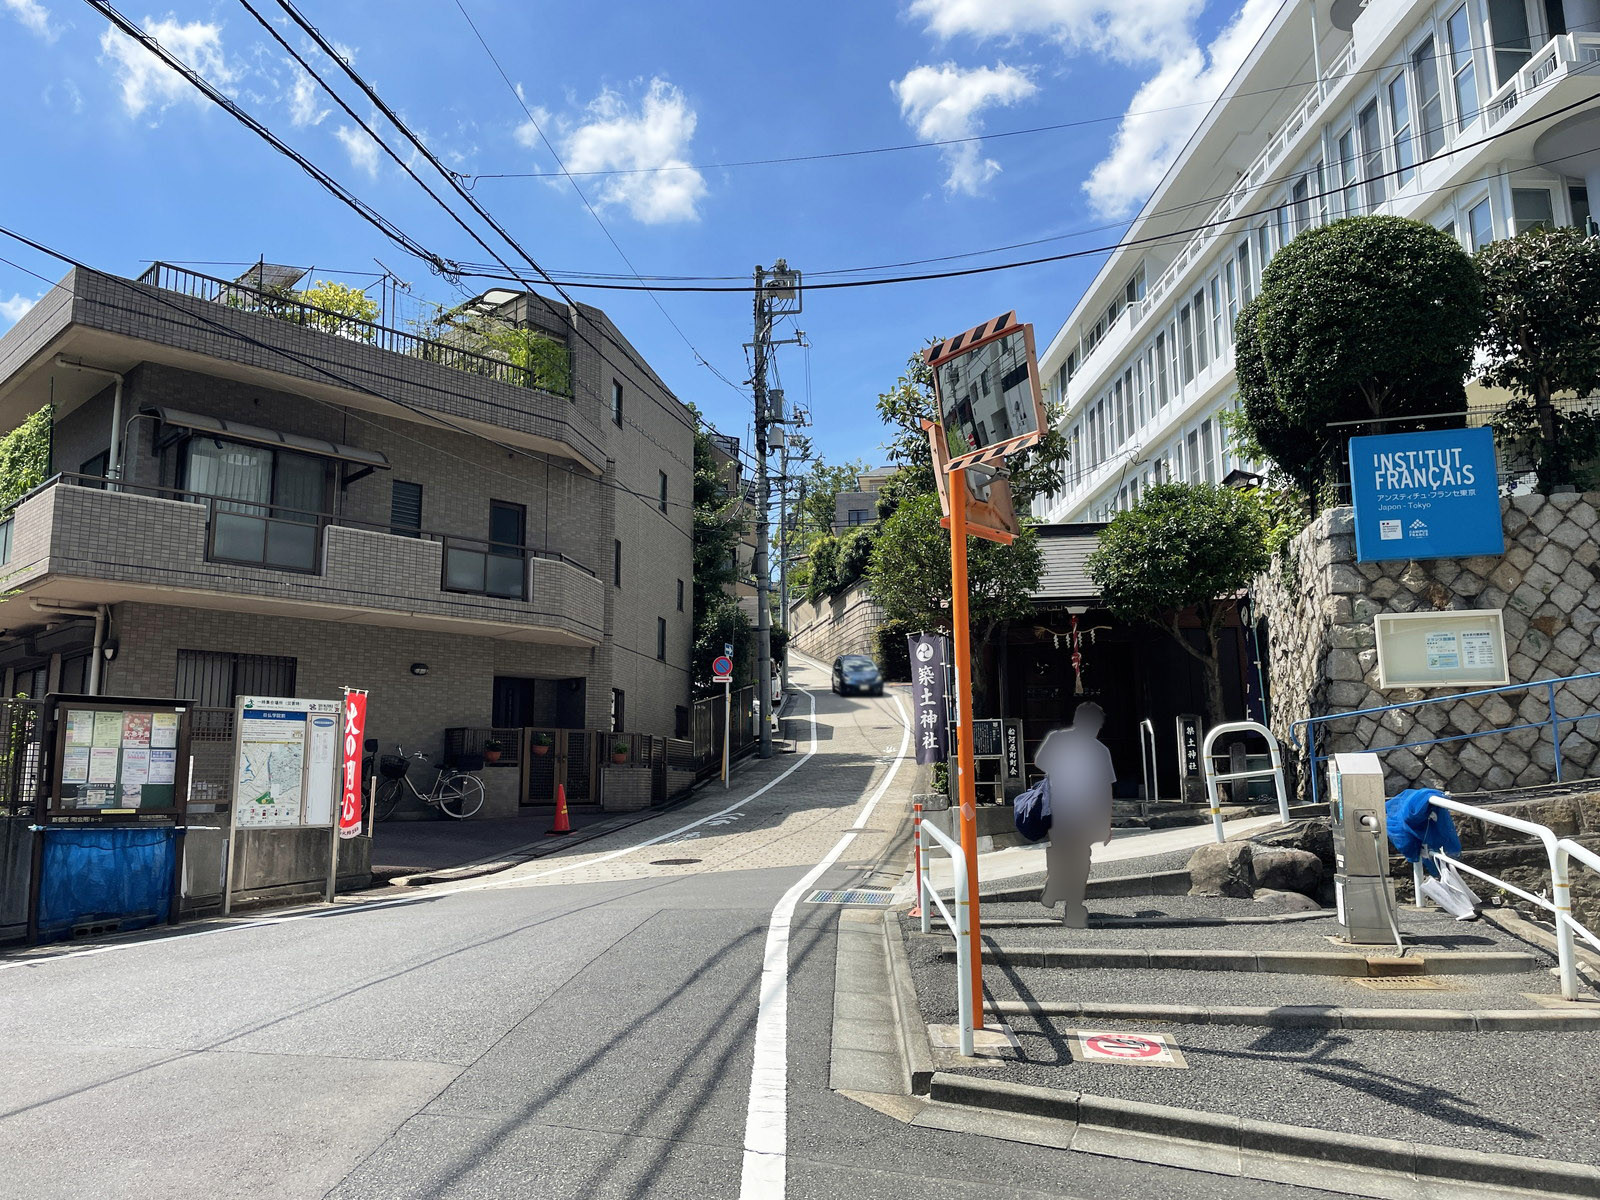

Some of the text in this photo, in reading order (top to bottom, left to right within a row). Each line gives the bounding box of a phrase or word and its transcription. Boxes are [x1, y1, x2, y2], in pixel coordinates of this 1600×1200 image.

[1373, 447, 1462, 474] INSTITUT
[1375, 464, 1475, 491] FRANÇAIS
[1378, 503, 1402, 512] Japon
[1407, 501, 1432, 510] Tokyo
[918, 666, 939, 750] 築土神社
[344, 702, 361, 822] 火の用心
